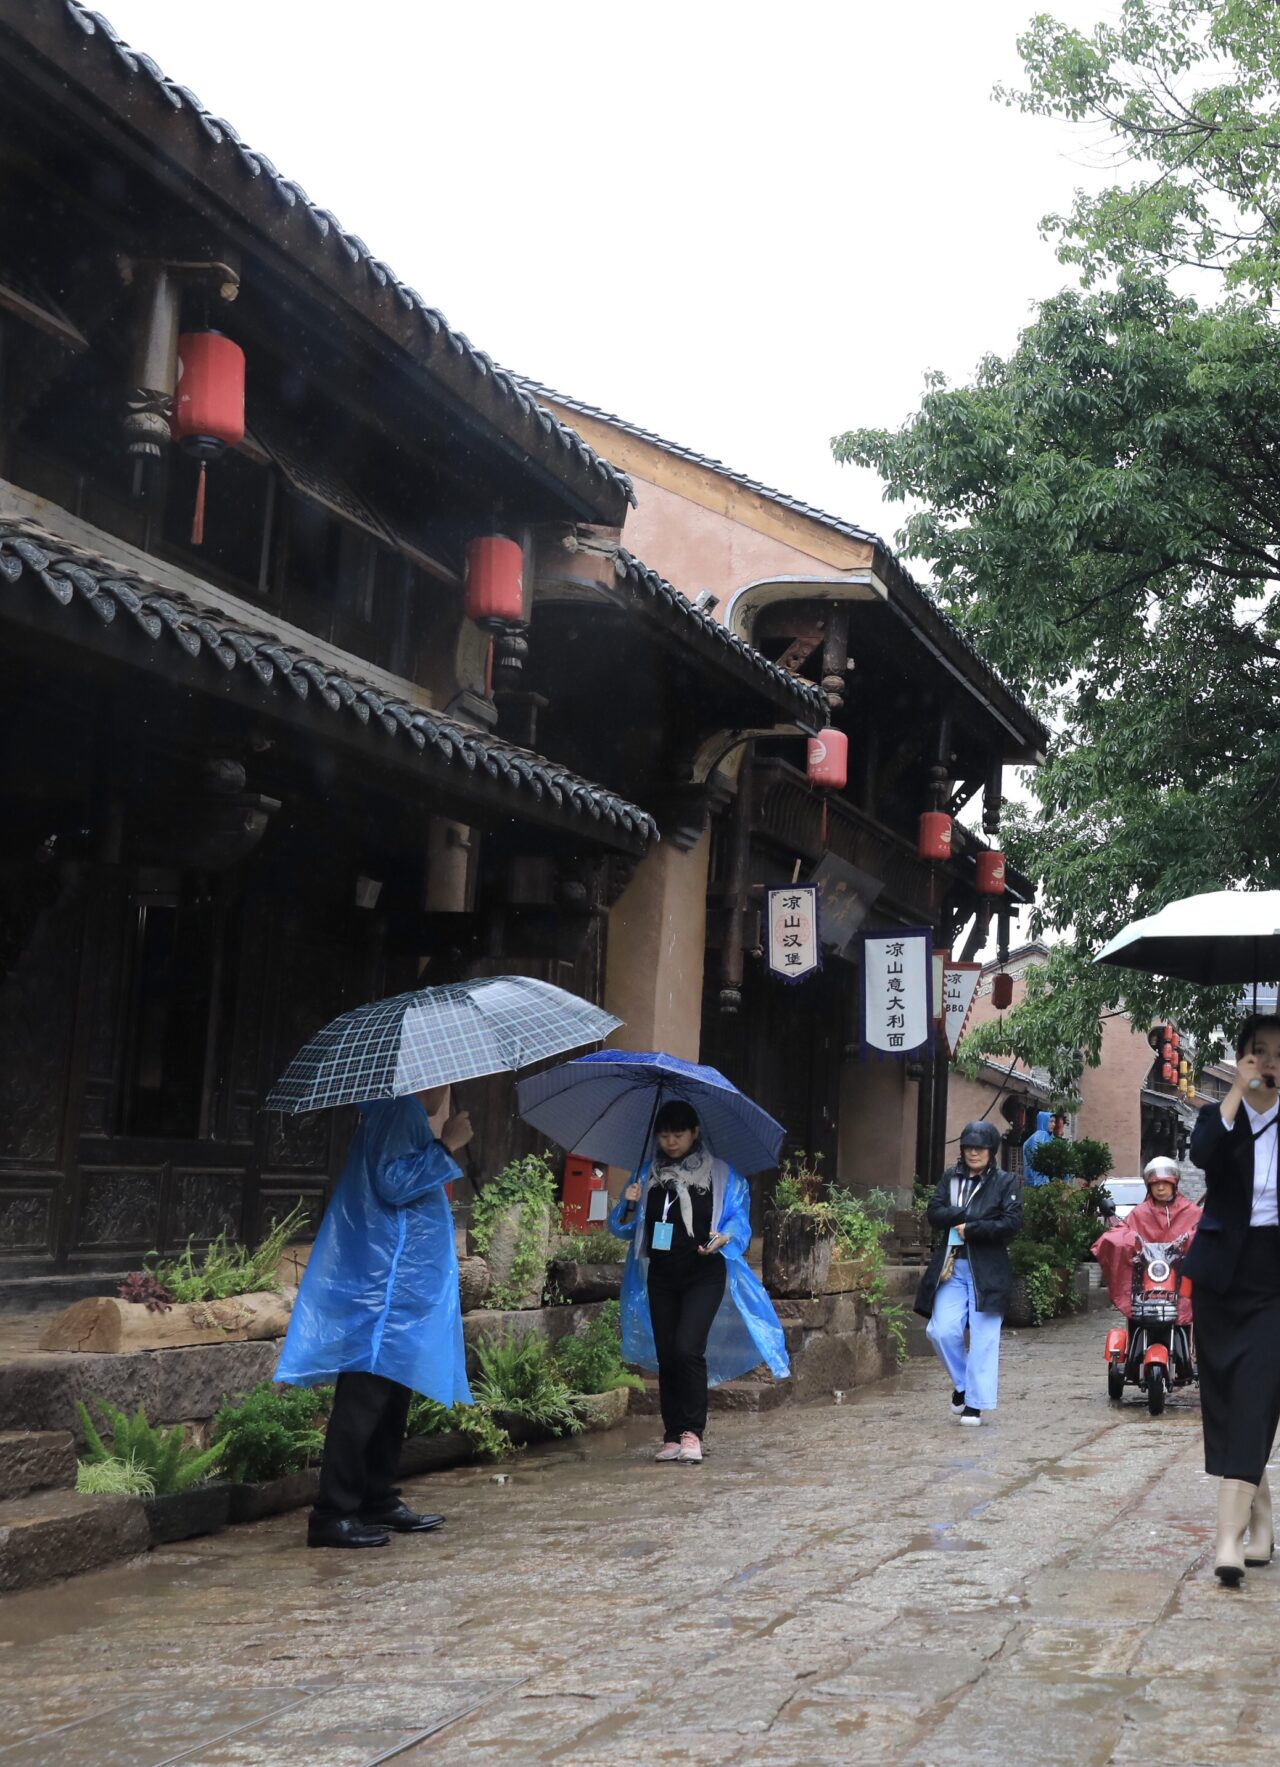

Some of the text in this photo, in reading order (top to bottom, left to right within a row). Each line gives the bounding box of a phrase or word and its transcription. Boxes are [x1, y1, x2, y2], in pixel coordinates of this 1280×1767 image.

[782, 896, 802, 966] 凉山汉堡
[885, 942, 905, 1047] 凉山意大利面
[946, 1004, 964, 1012] BBQ
[947, 974, 962, 998] 凉山
